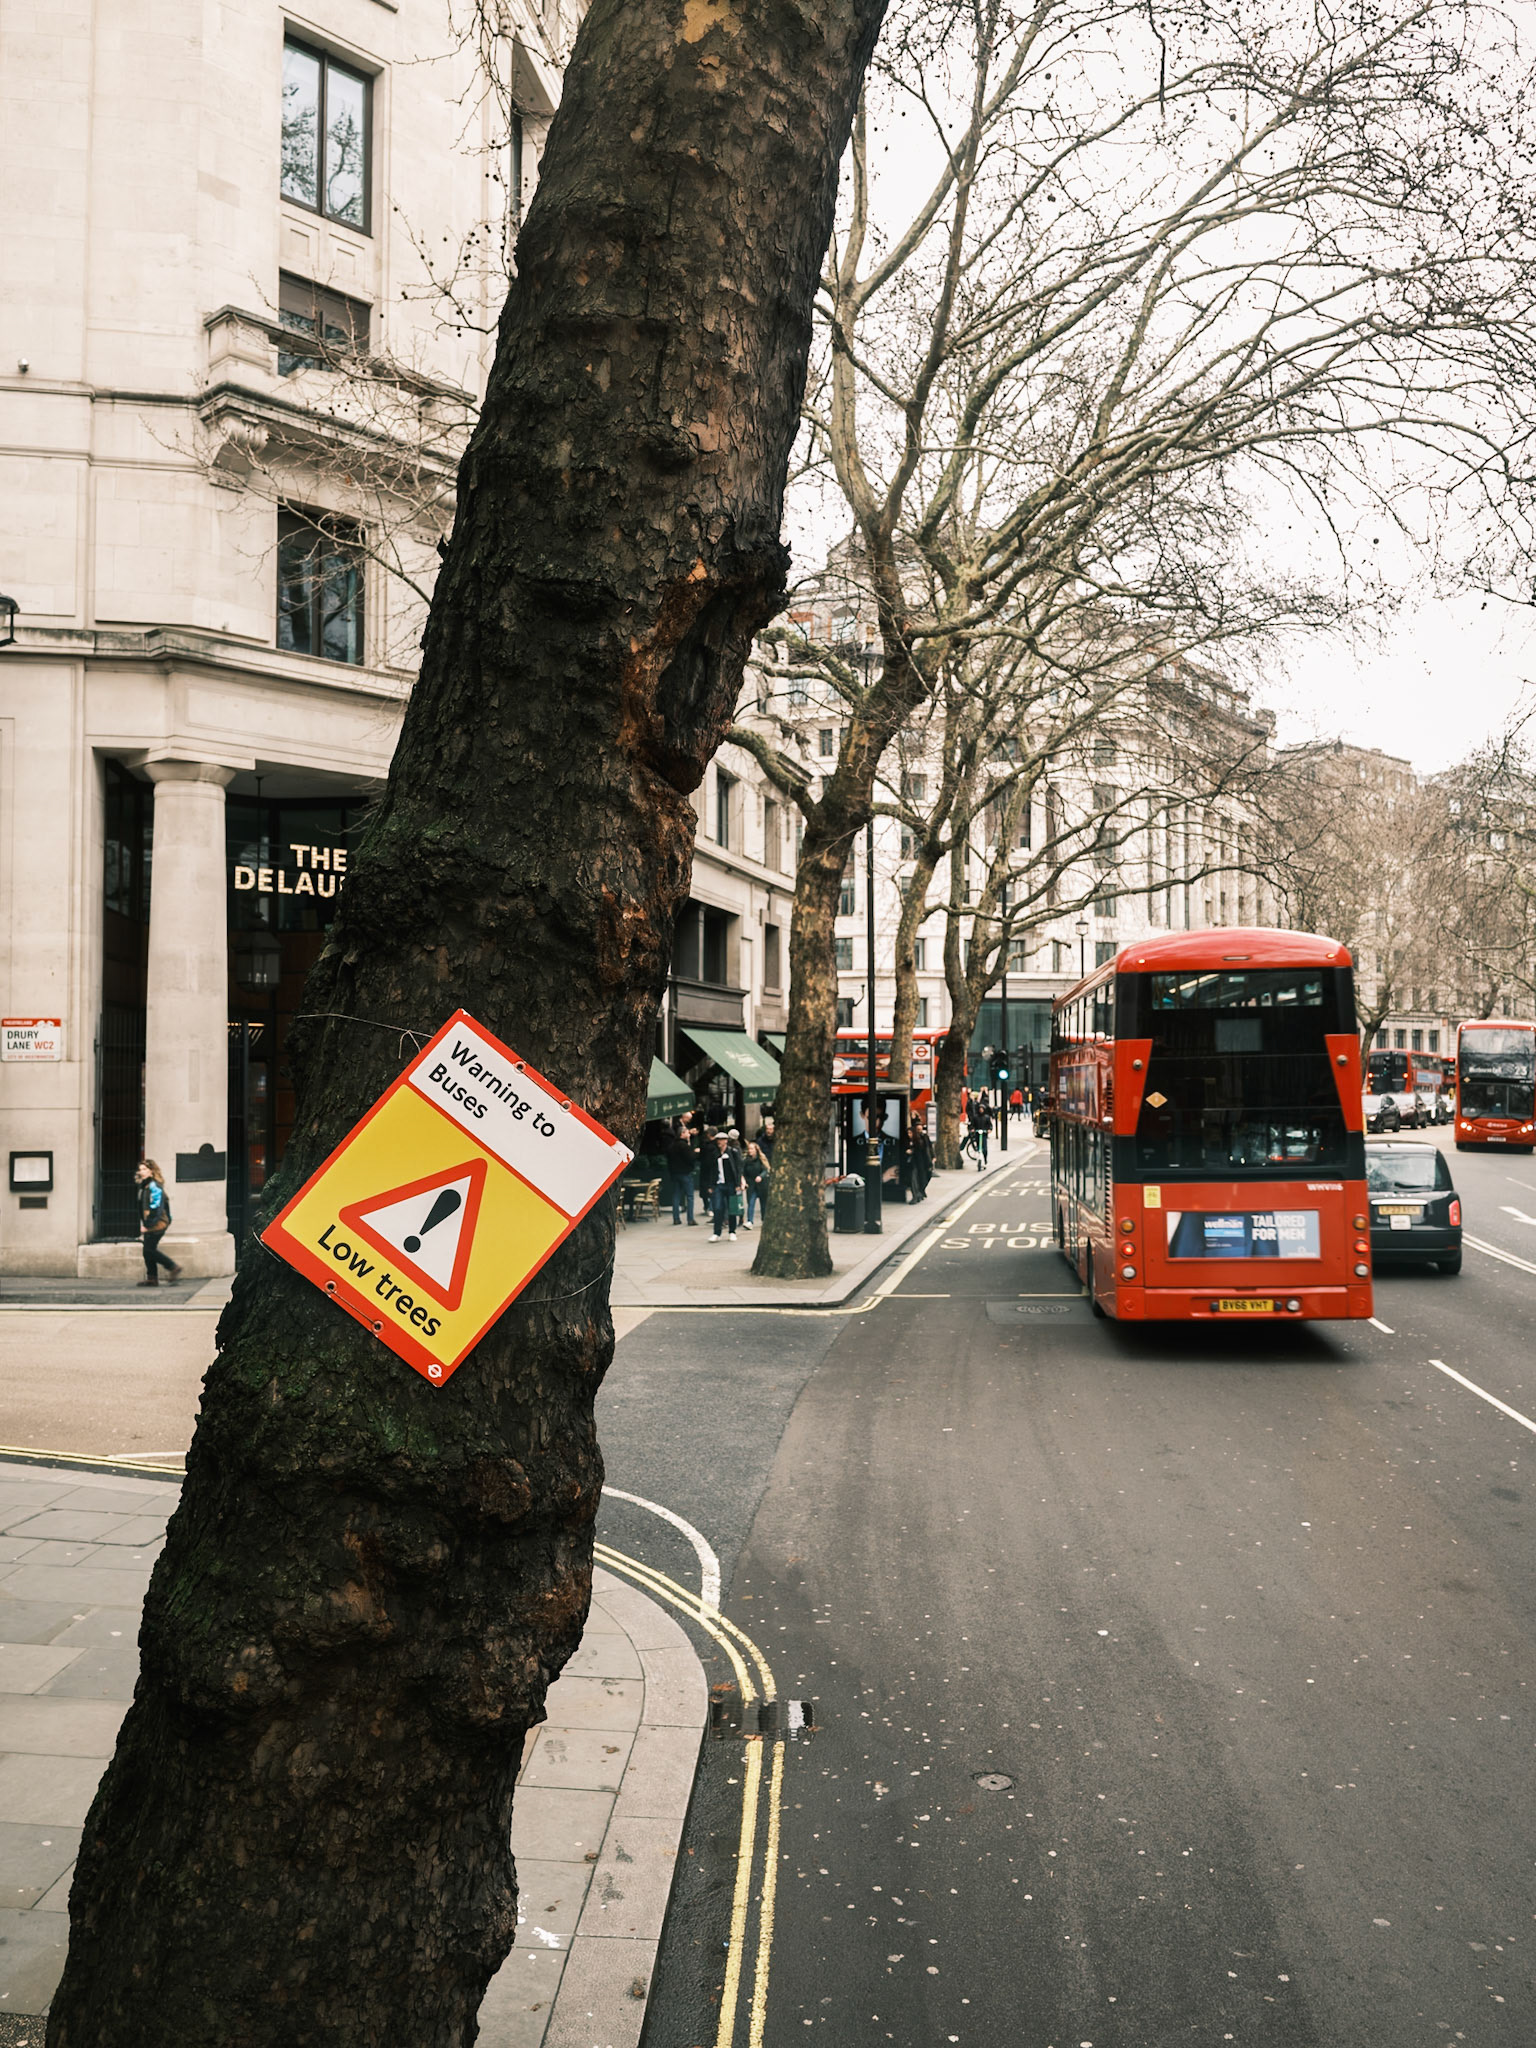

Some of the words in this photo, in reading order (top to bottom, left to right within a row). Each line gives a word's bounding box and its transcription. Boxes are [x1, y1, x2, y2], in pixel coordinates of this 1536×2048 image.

[289, 843, 348, 873] THE
[234, 865, 346, 899] DELAU
[7, 1030, 39, 1039] DRURY
[7, 1041, 30, 1049] LANE
[34, 1041, 54, 1049] WC2
[428, 1062, 489, 1119] Buses
[450, 1040, 532, 1121] Warning
[532, 1112, 556, 1137] to
[968, 1222, 1055, 1234] BUS
[1251, 1215, 1307, 1228] TAILORED
[1251, 1228, 1277, 1241] FOR
[1278, 1228, 1307, 1240] MEN
[317, 1224, 375, 1278] Low
[375, 1273, 442, 1337] trees
